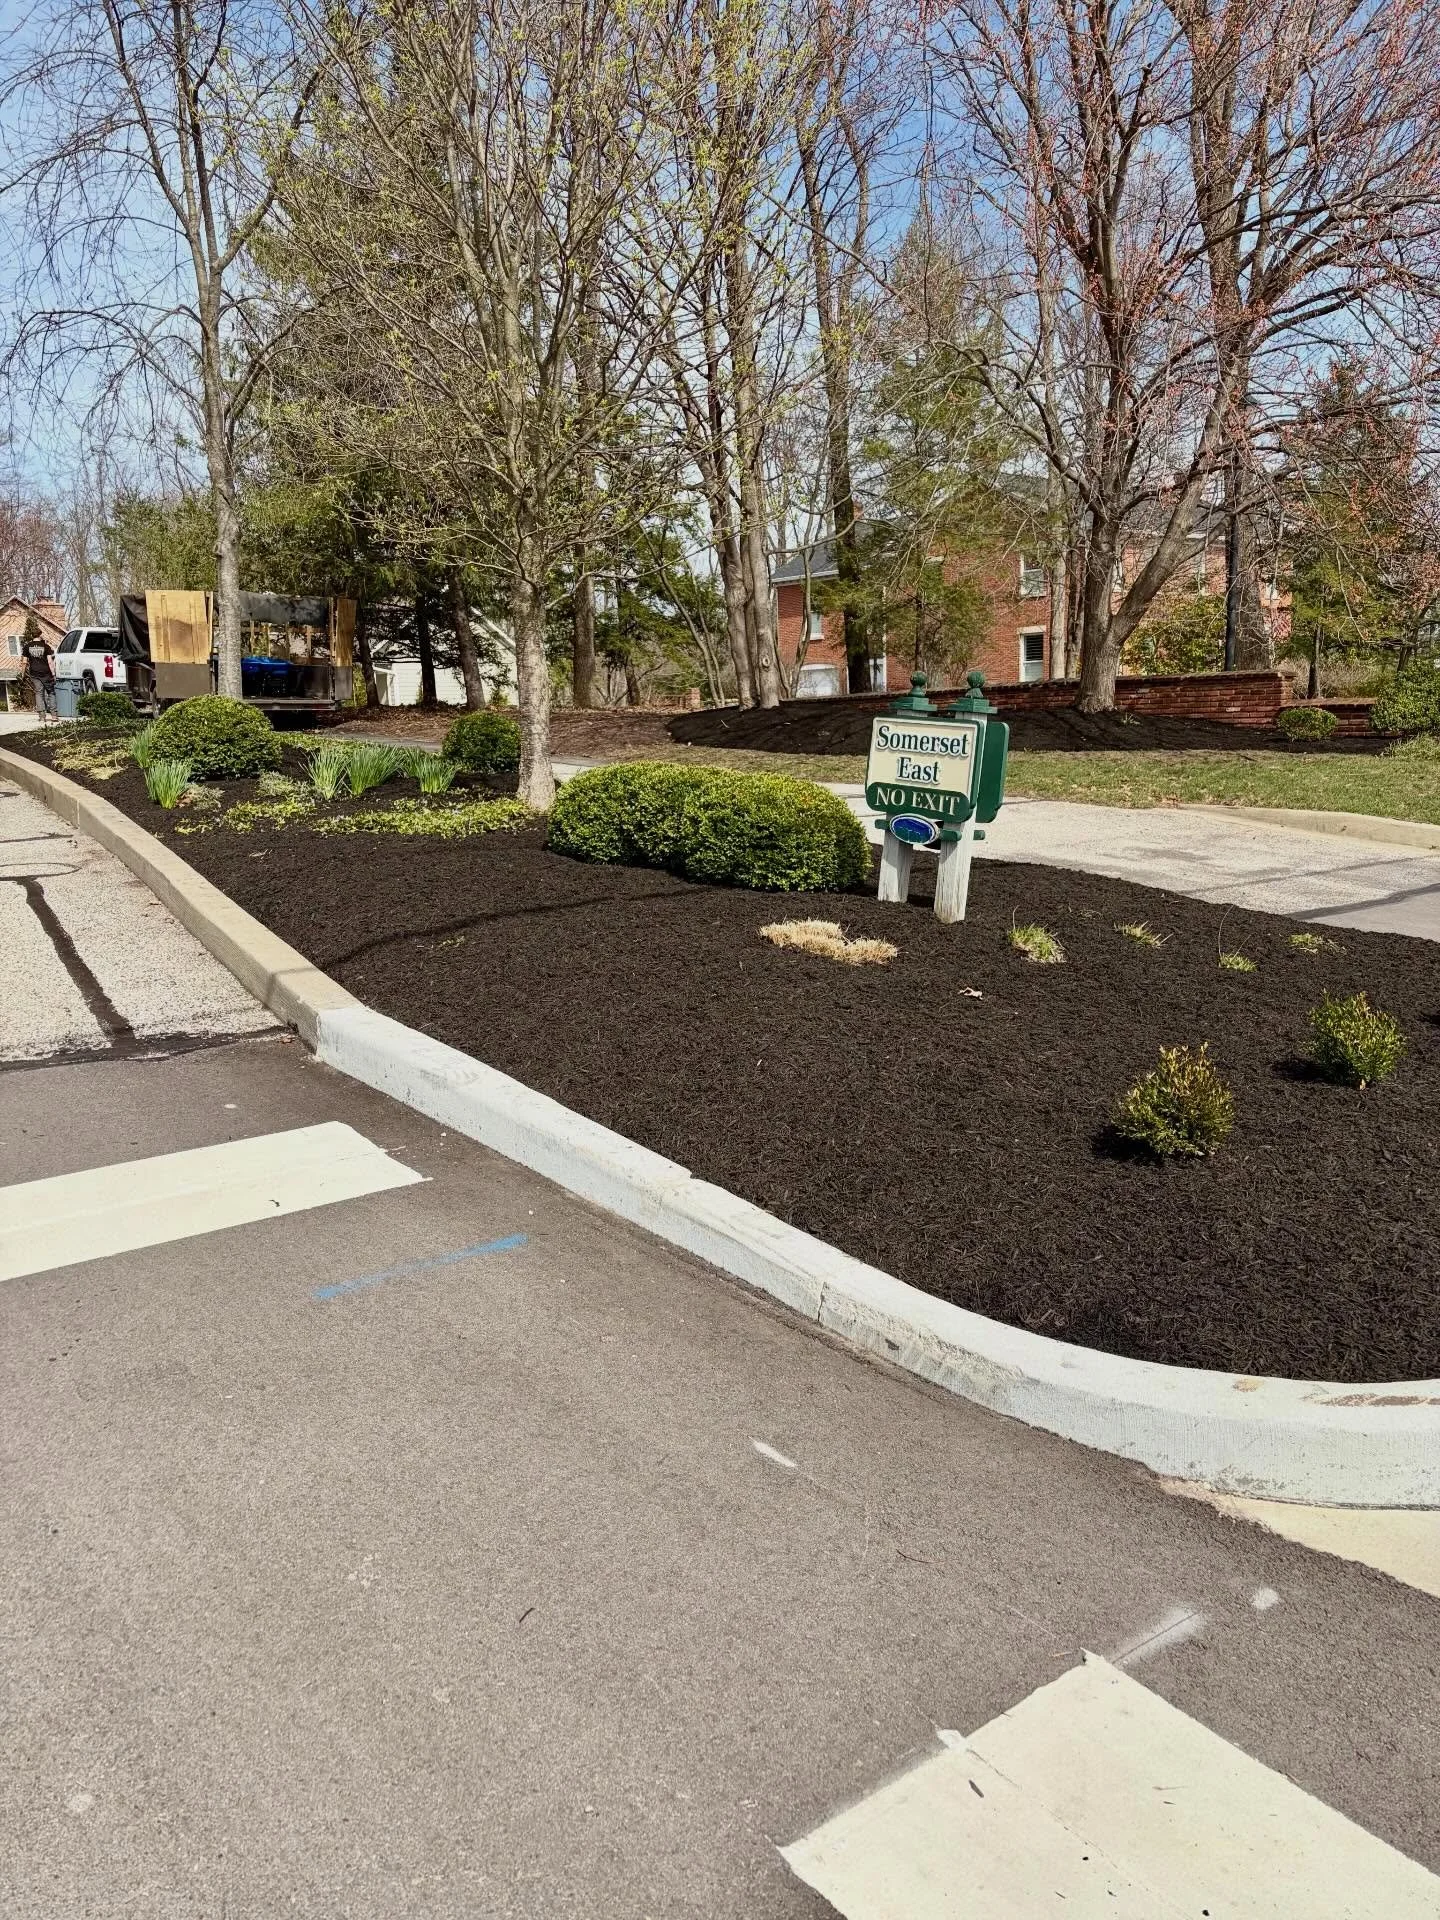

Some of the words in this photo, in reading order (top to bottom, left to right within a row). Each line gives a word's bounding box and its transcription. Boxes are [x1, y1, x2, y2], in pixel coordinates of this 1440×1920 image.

[877, 725, 969, 755] Somerset
[898, 756, 939, 782] East
[874, 787, 906, 807] NO
[911, 791, 960, 816] EXIT
